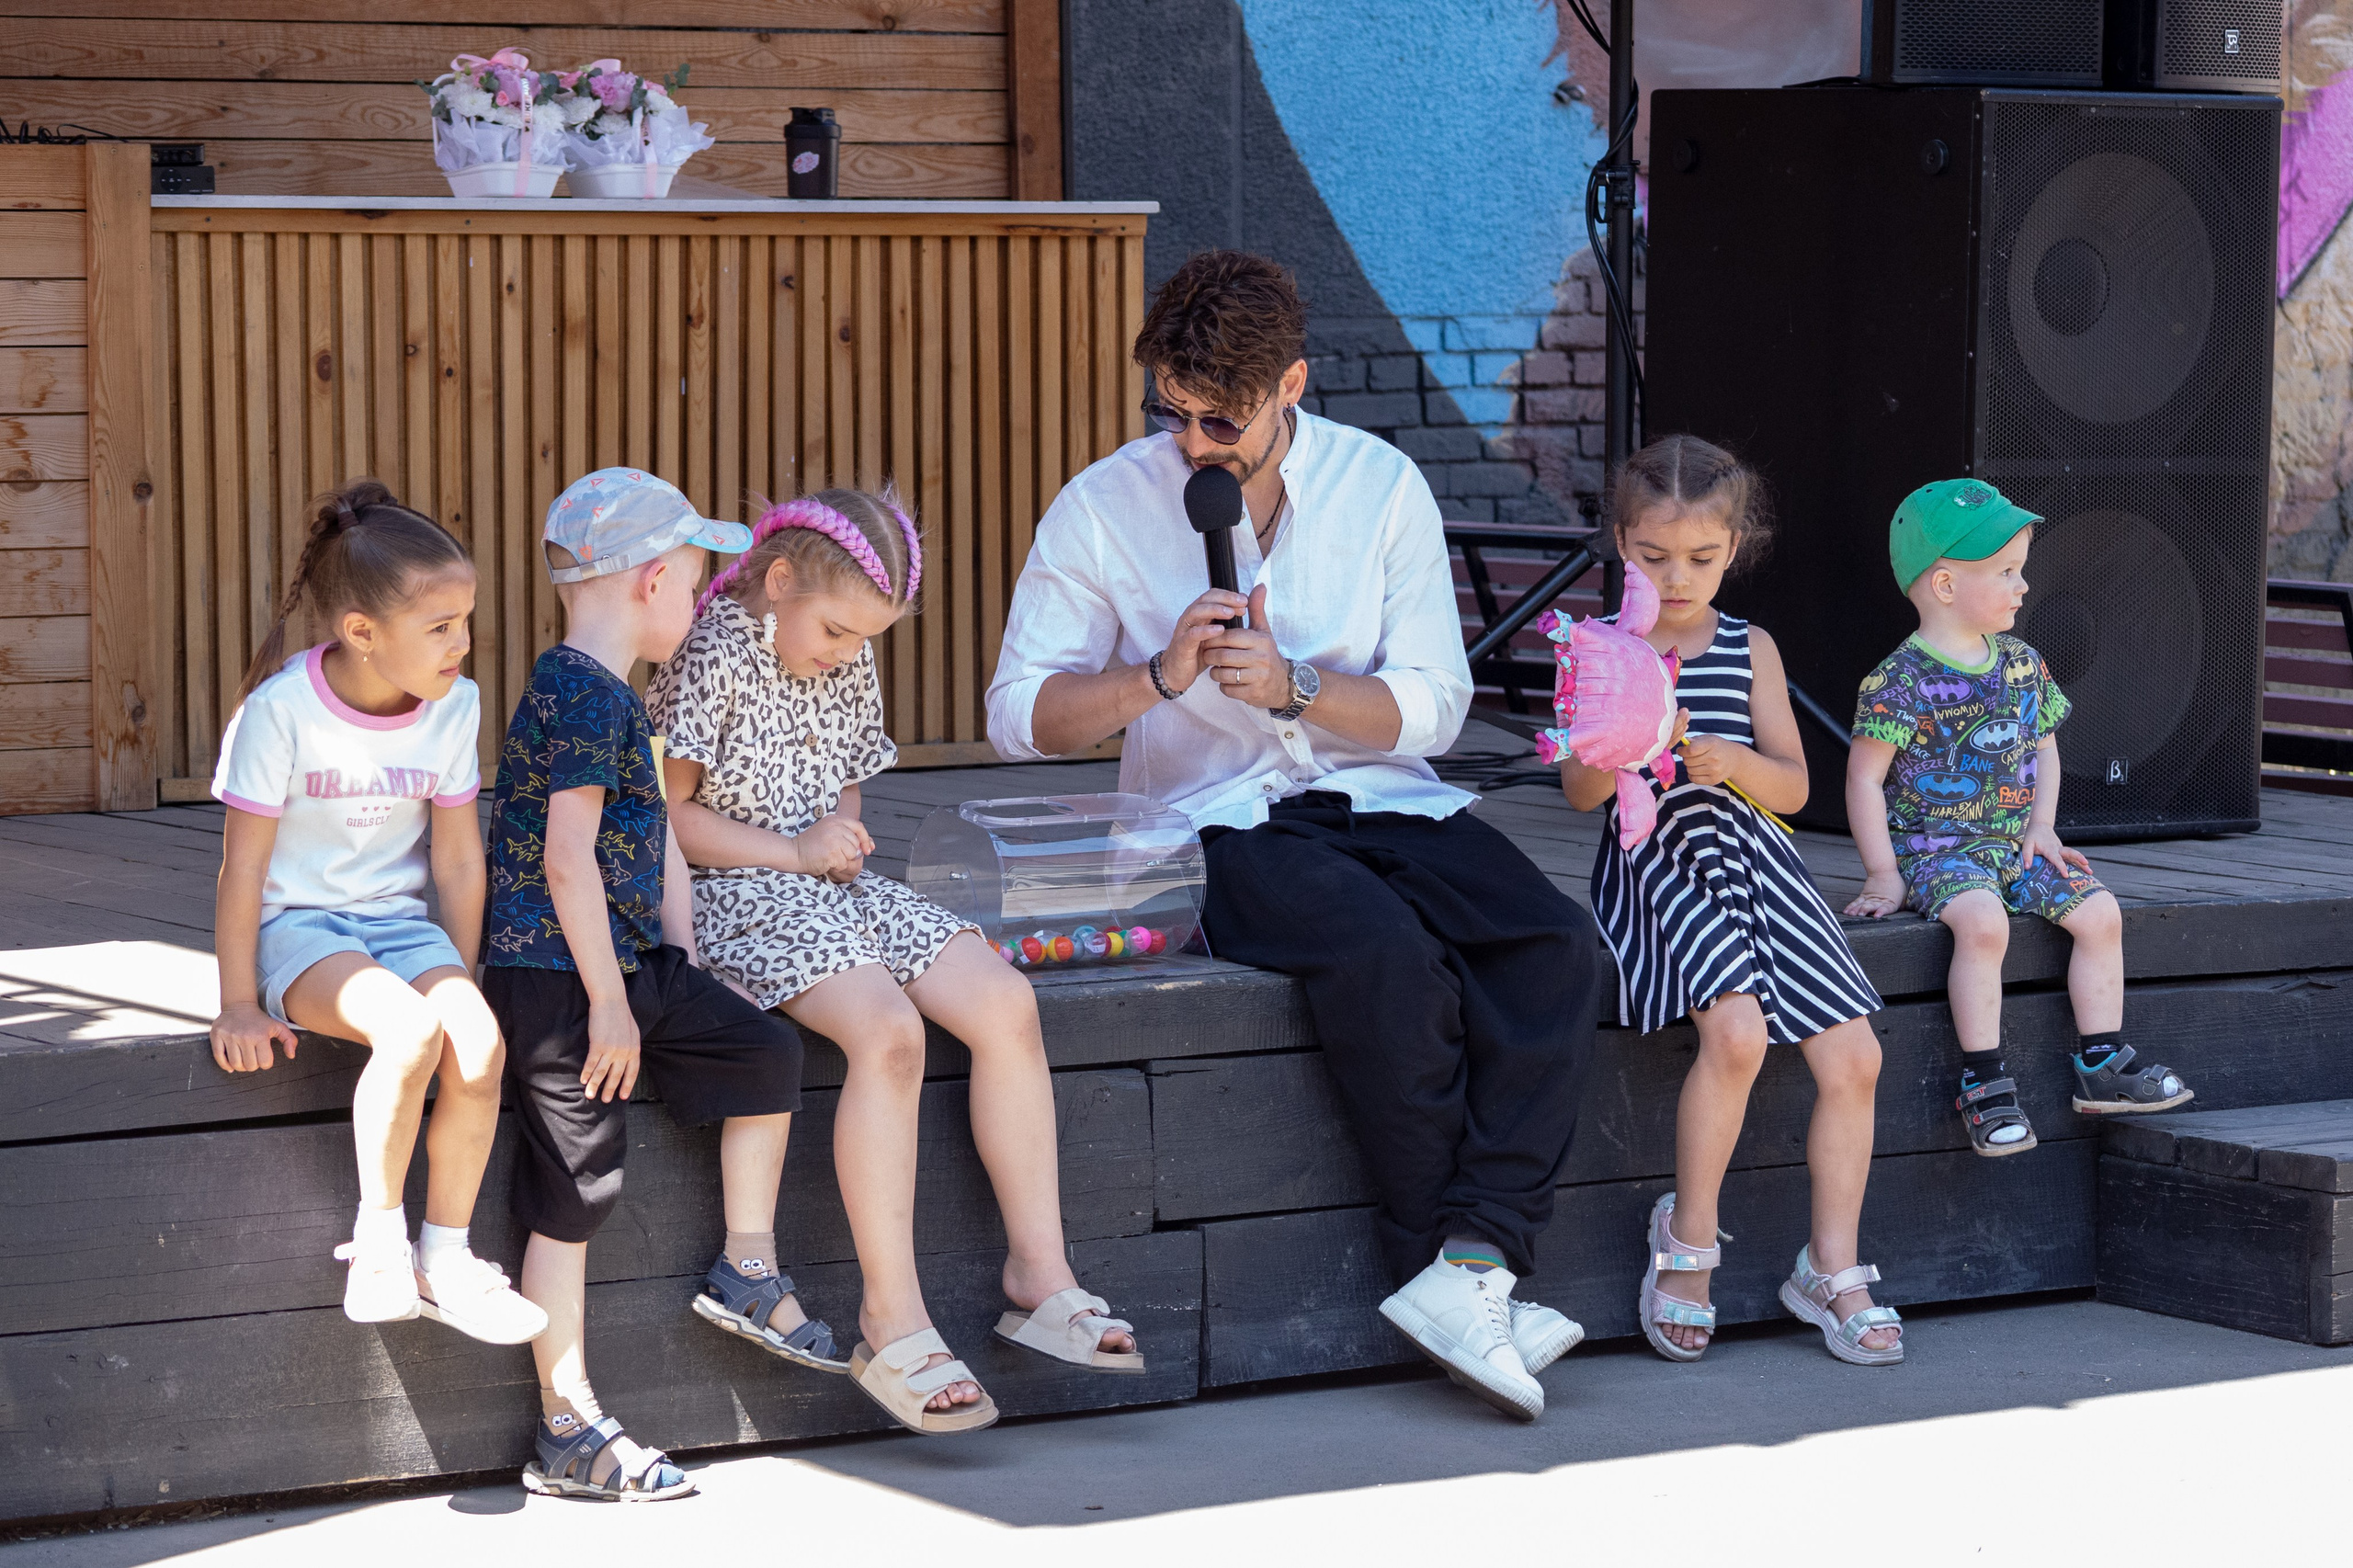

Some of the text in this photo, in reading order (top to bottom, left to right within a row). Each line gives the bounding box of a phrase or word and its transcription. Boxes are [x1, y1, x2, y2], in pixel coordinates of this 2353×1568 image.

[1895, 752, 1918, 773] MR
[1900, 757, 1945, 786] FREEZE
[1960, 754, 1995, 773] BANE
[347, 814, 374, 827] GIRLS
